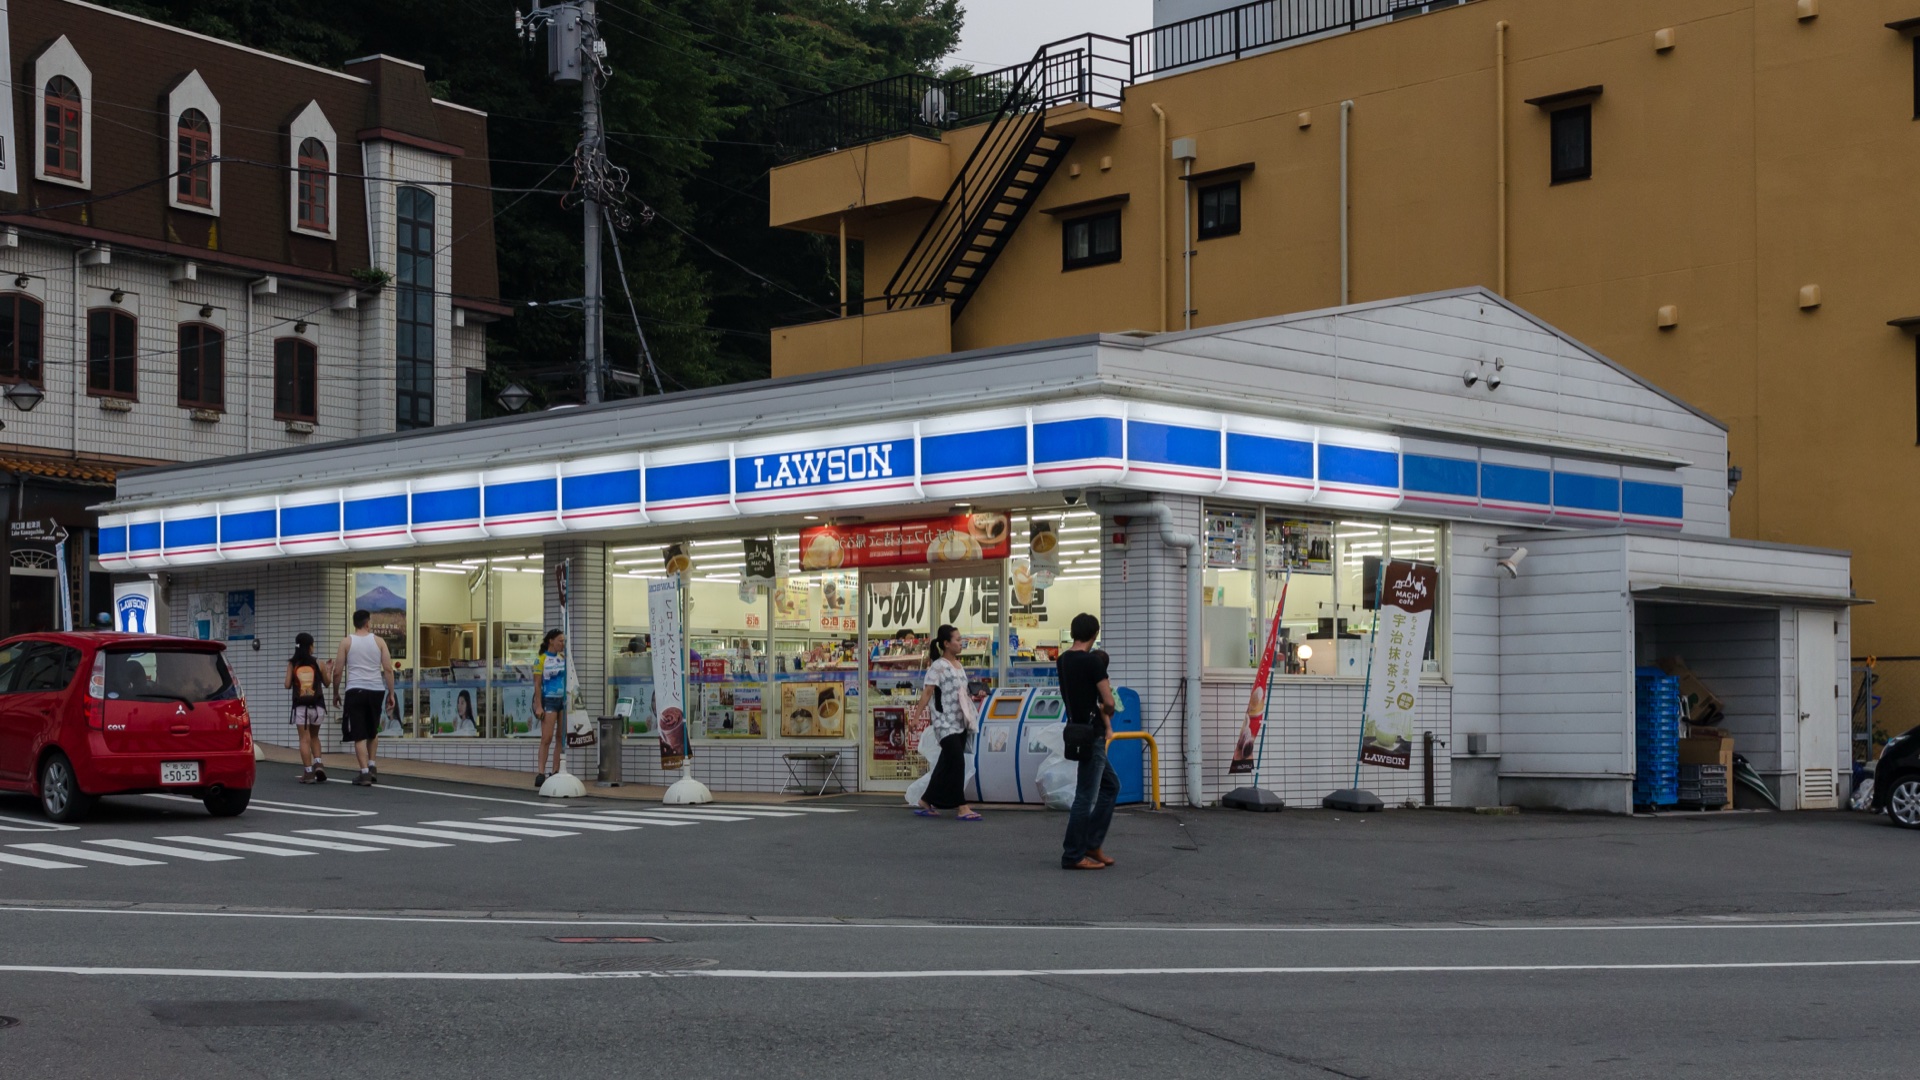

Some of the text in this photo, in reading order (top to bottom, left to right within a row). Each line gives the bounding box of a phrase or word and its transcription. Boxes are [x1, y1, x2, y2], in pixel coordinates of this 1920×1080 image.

[754, 442, 893, 490] LAWSON
[1395, 590, 1420, 600] MACHI
[119, 599, 146, 611] LAWSON
[1398, 597, 1414, 606] café
[842, 619, 856, 628] お酒
[1407, 615, 1418, 646] ちょっと
[1384, 613, 1407, 709] 宇治抹茶ラテ
[1363, 752, 1407, 766] LAWSON
[169, 770, 197, 781] 50-55
